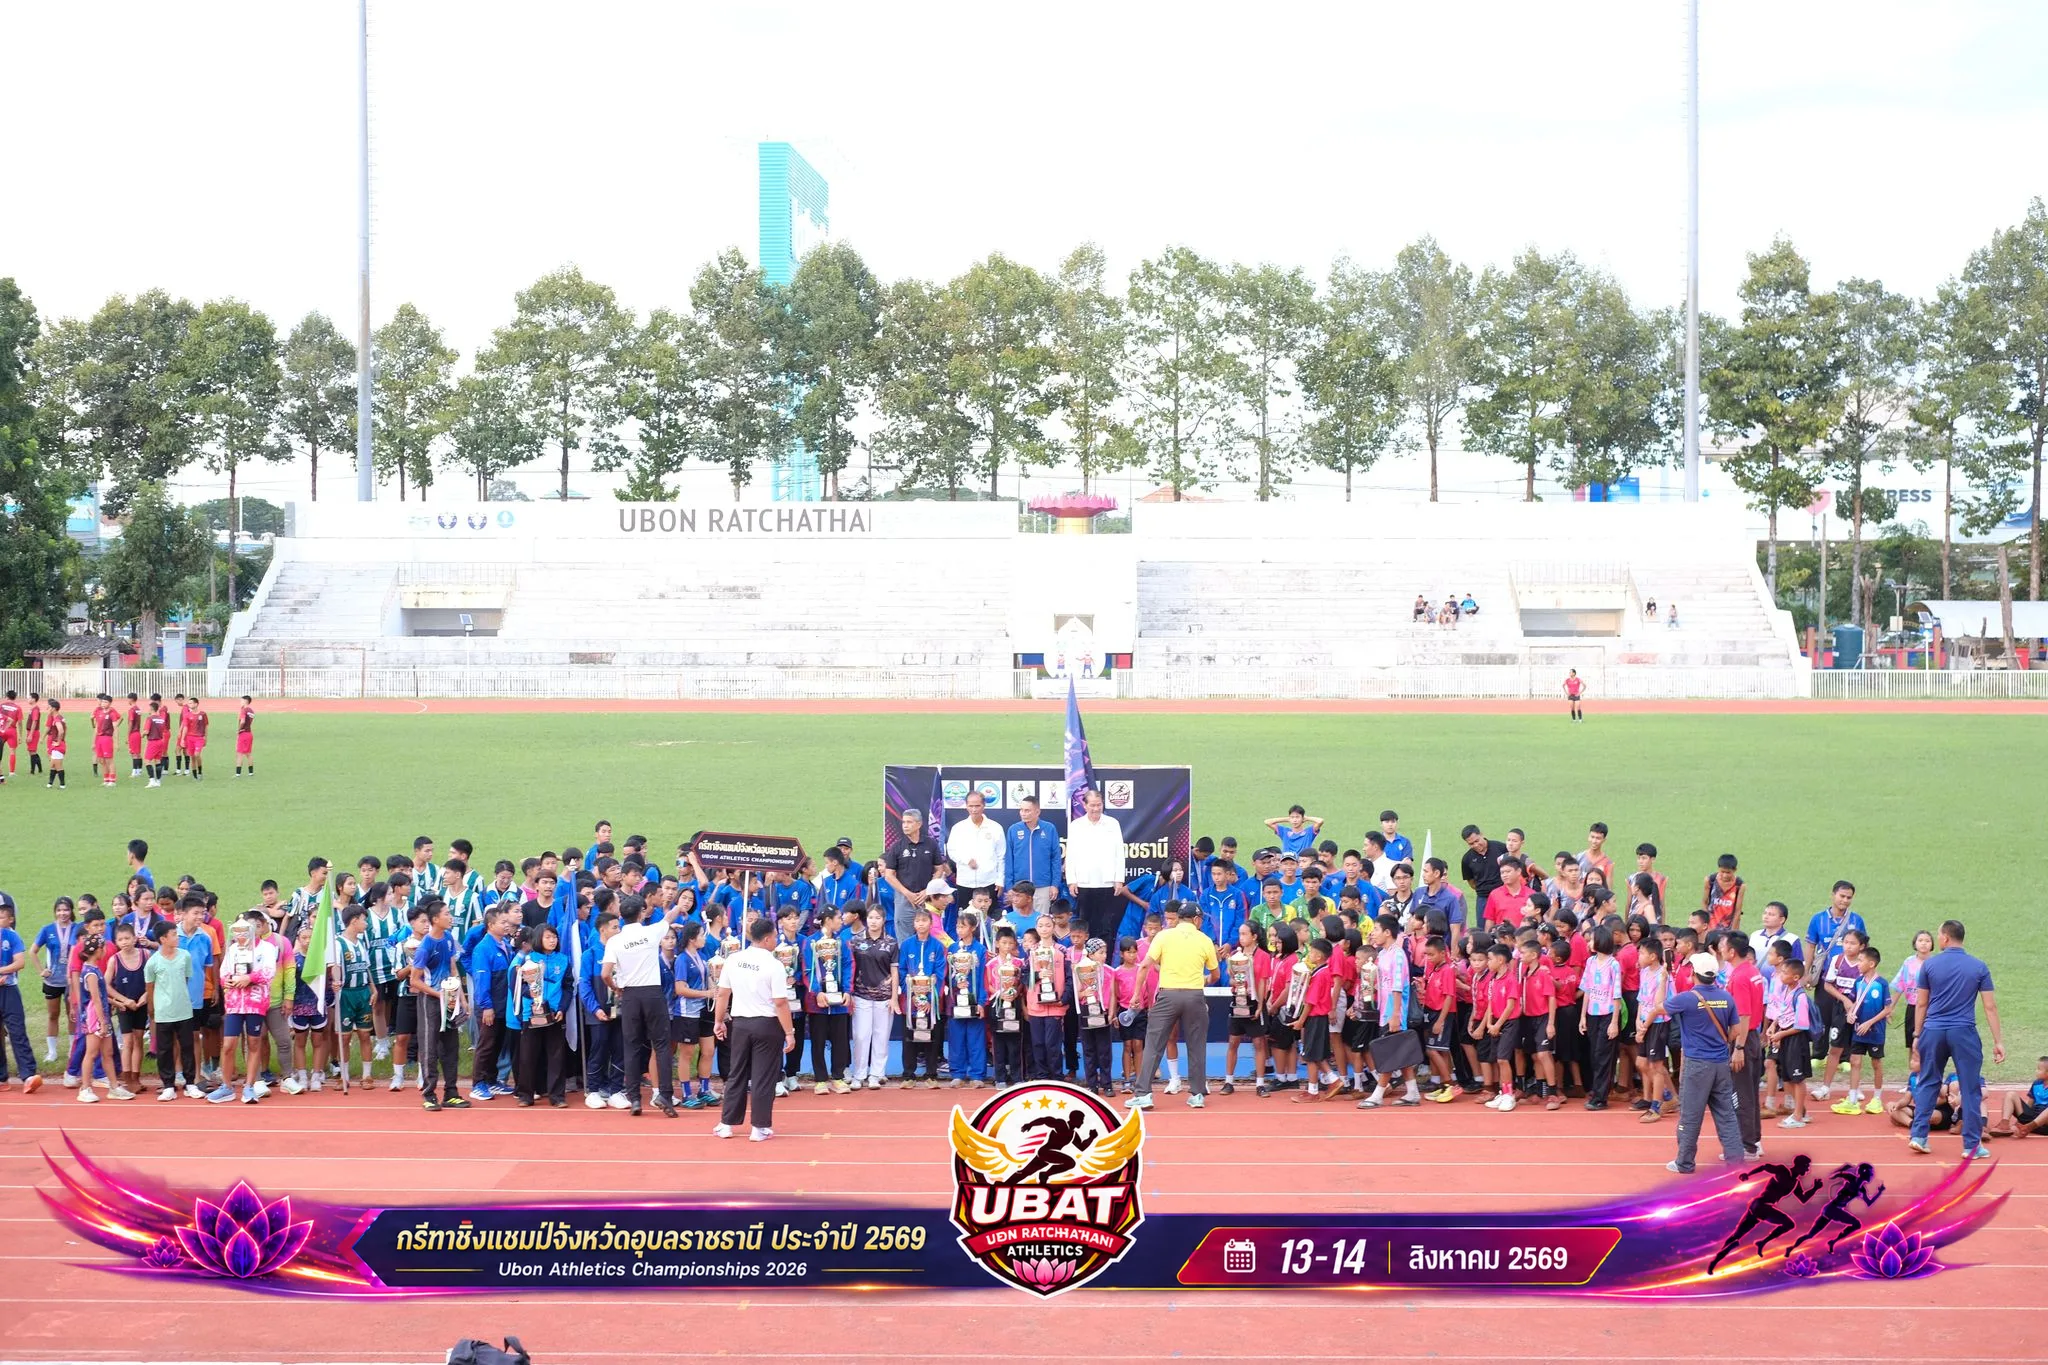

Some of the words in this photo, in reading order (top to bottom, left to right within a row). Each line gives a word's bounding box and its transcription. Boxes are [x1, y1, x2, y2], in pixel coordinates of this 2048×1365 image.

[619, 508, 697, 533] UBON
[708, 508, 872, 533] RATCHATHA
[751, 857, 795, 865] CHAMPIONSHIPS
